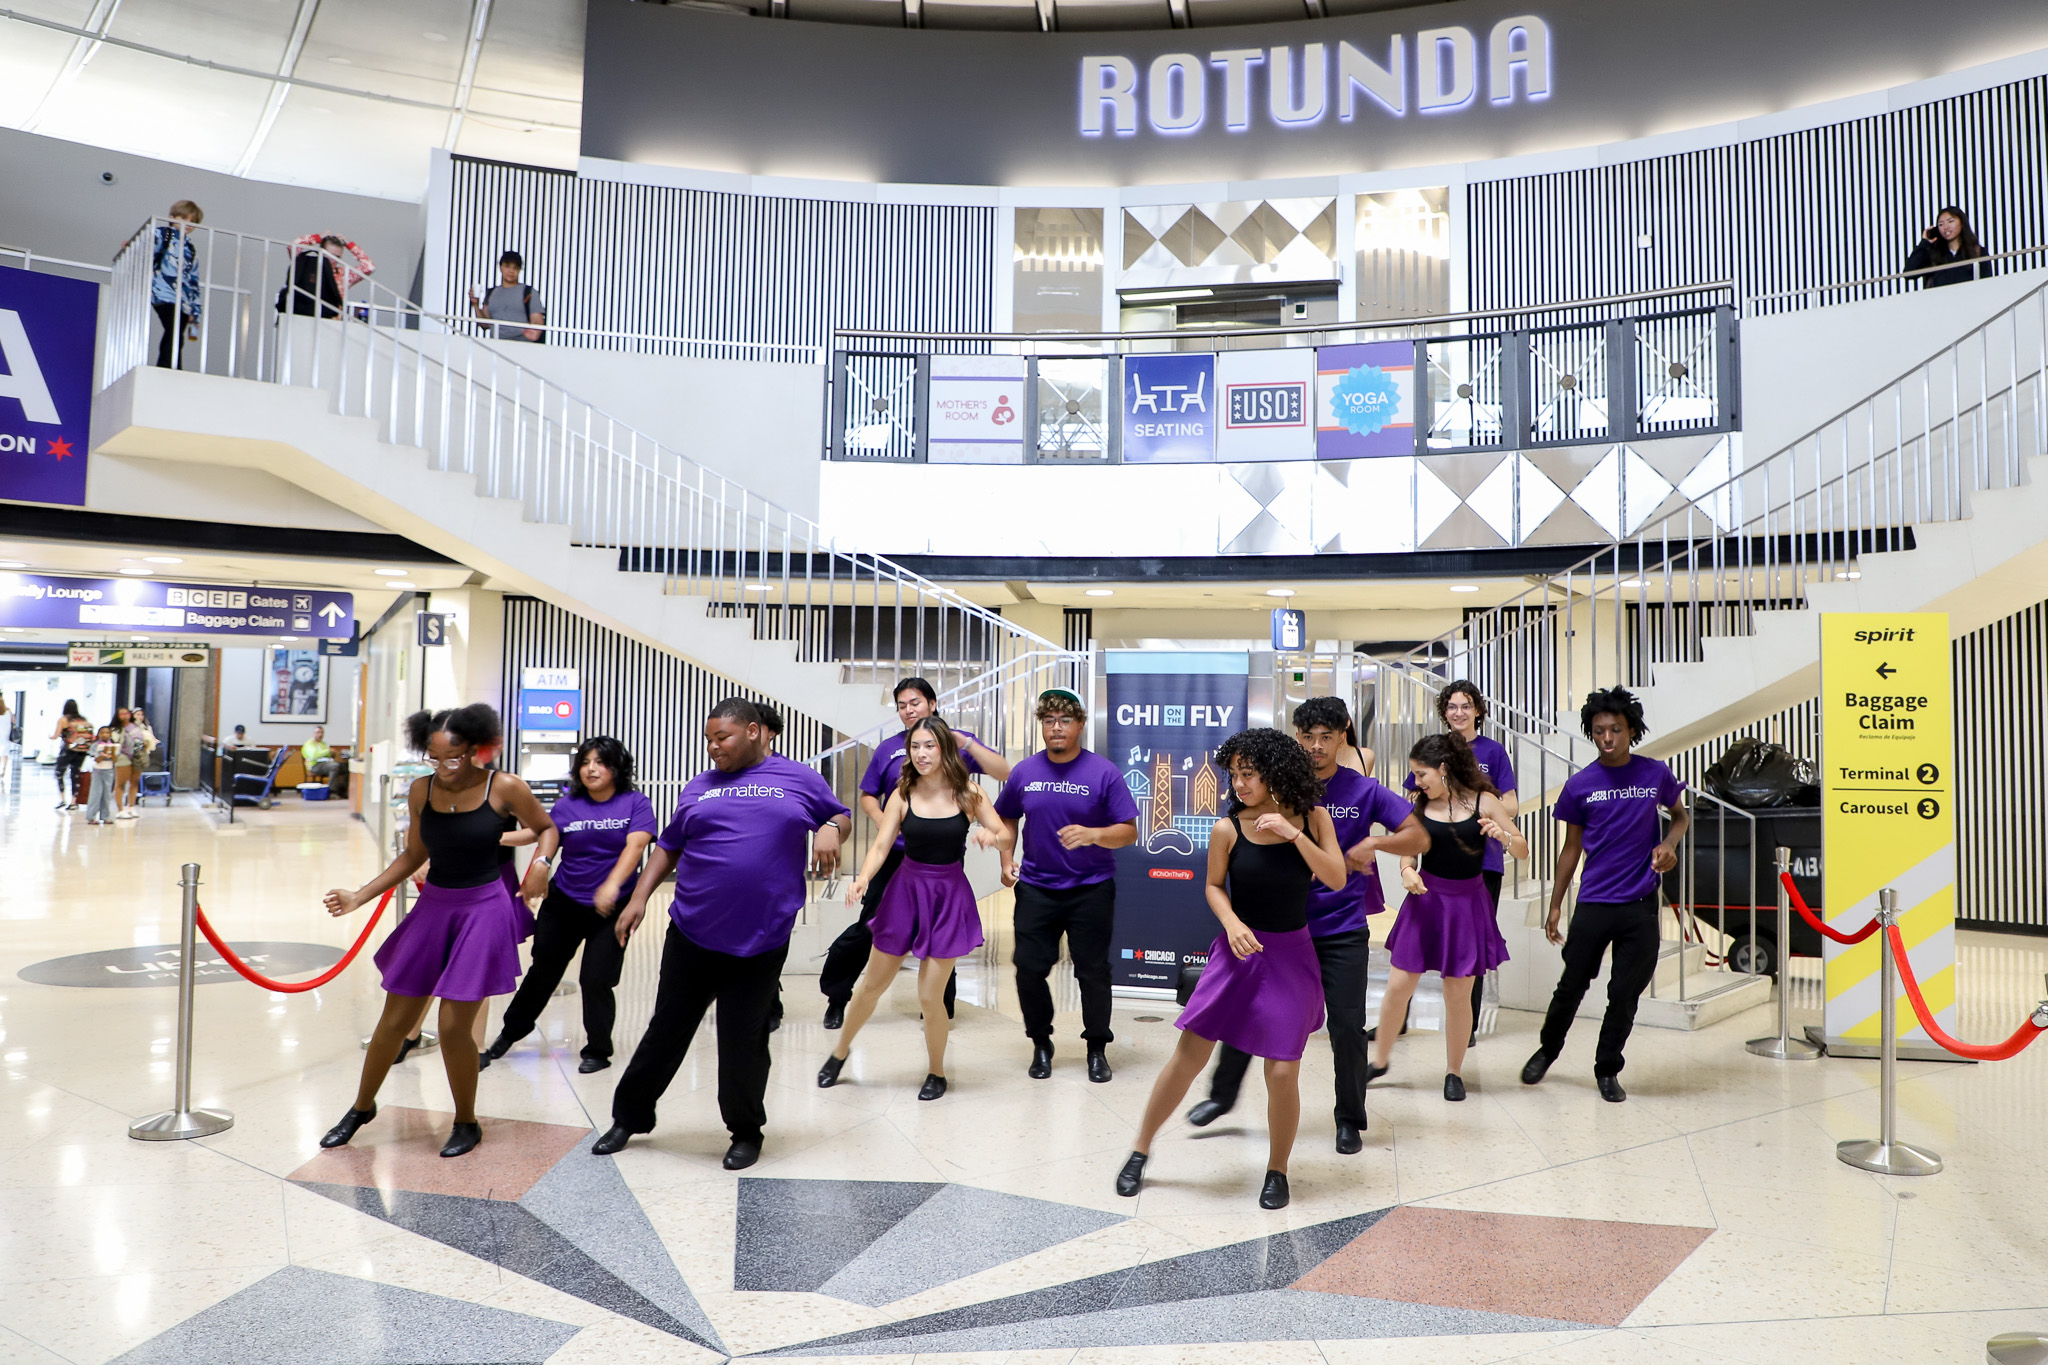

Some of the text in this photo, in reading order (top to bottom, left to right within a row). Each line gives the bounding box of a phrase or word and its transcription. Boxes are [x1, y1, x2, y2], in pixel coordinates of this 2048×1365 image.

[1081, 14, 1551, 135] ROTUNDA
[936, 400, 987, 410] MOTHER'S
[1243, 390, 1289, 421] USO
[1342, 391, 1389, 406] YOGA
[945, 411, 979, 421] ROOM
[1350, 405, 1380, 414] ROOM
[1134, 423, 1204, 438] SEATING
[47, 585, 103, 602] Lounge
[192, 592, 205, 605] C
[213, 593, 223, 606] E
[233, 594, 243, 607] F
[249, 596, 289, 608] Gates
[186, 612, 285, 628] Baggage Claim
[1854, 628, 1915, 645] spirit
[537, 674, 568, 686] ATM
[1845, 693, 1928, 711] Baggage
[1116, 704, 1160, 726] CHI
[1190, 705, 1234, 727] FLY
[1859, 715, 1915, 730] Claim
[1840, 766, 1934, 782] Terminal 2
[721, 783, 785, 798] matters
[1042, 780, 1090, 796] matters
[1607, 785, 1658, 800] matters
[1840, 801, 1934, 817] Carousel 3
[1145, 950, 1176, 962] CHICAGO
